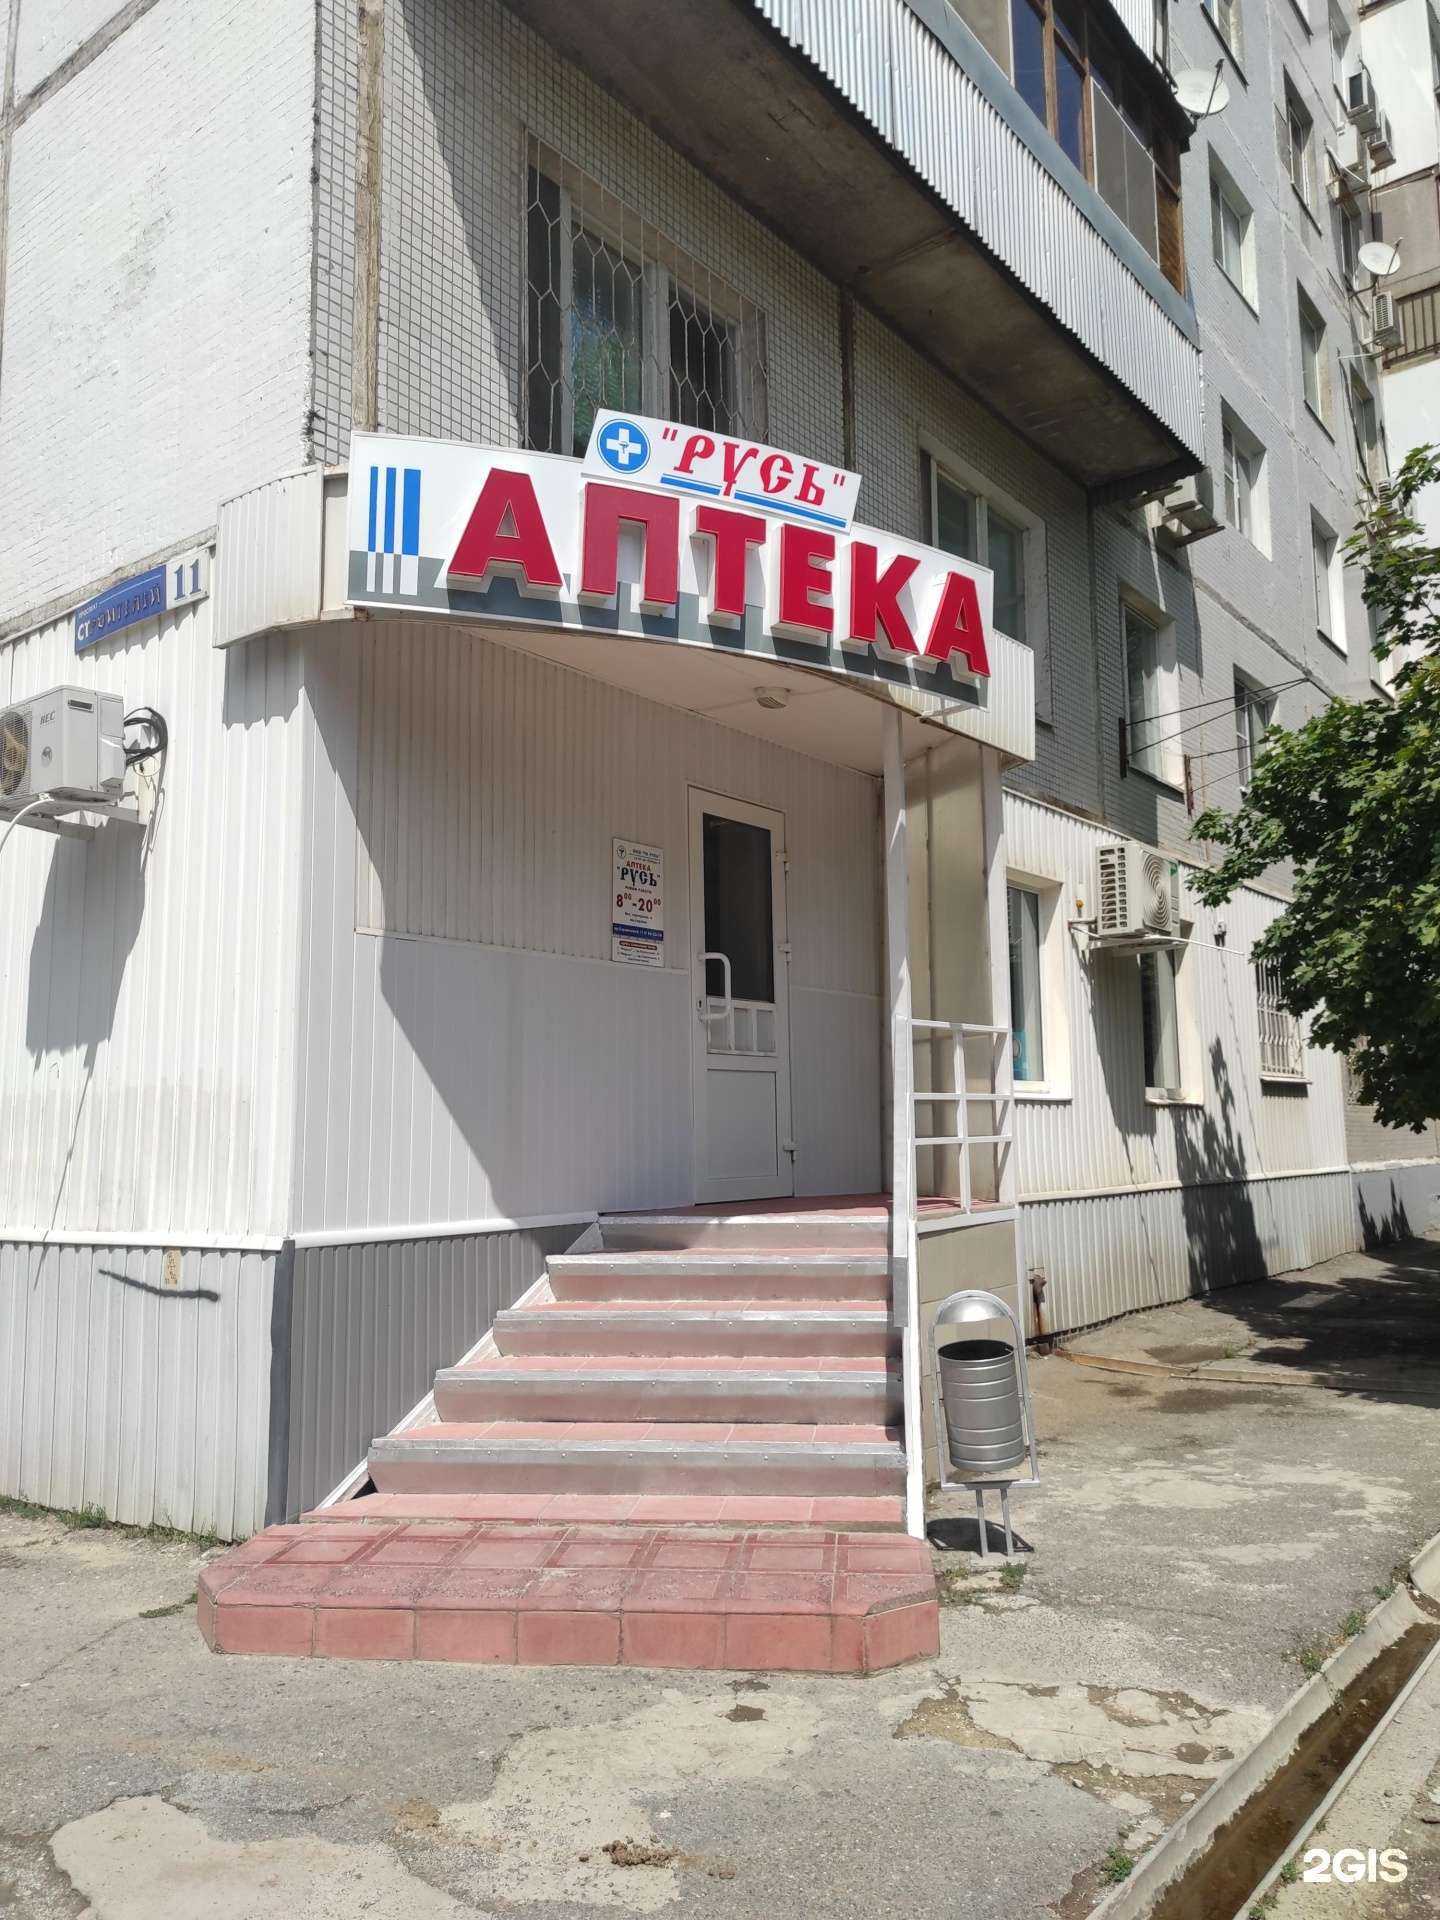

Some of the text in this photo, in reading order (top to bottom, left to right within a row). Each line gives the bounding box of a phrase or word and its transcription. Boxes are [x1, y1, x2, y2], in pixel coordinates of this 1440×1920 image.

[661, 426, 846, 506] "РУСЬ"
[174, 558, 202, 601] 11
[447, 467, 991, 680] АПТЕКА
[616, 866, 661, 887] "РУСЬ"
[626, 860, 651, 872] АПТЕКА
